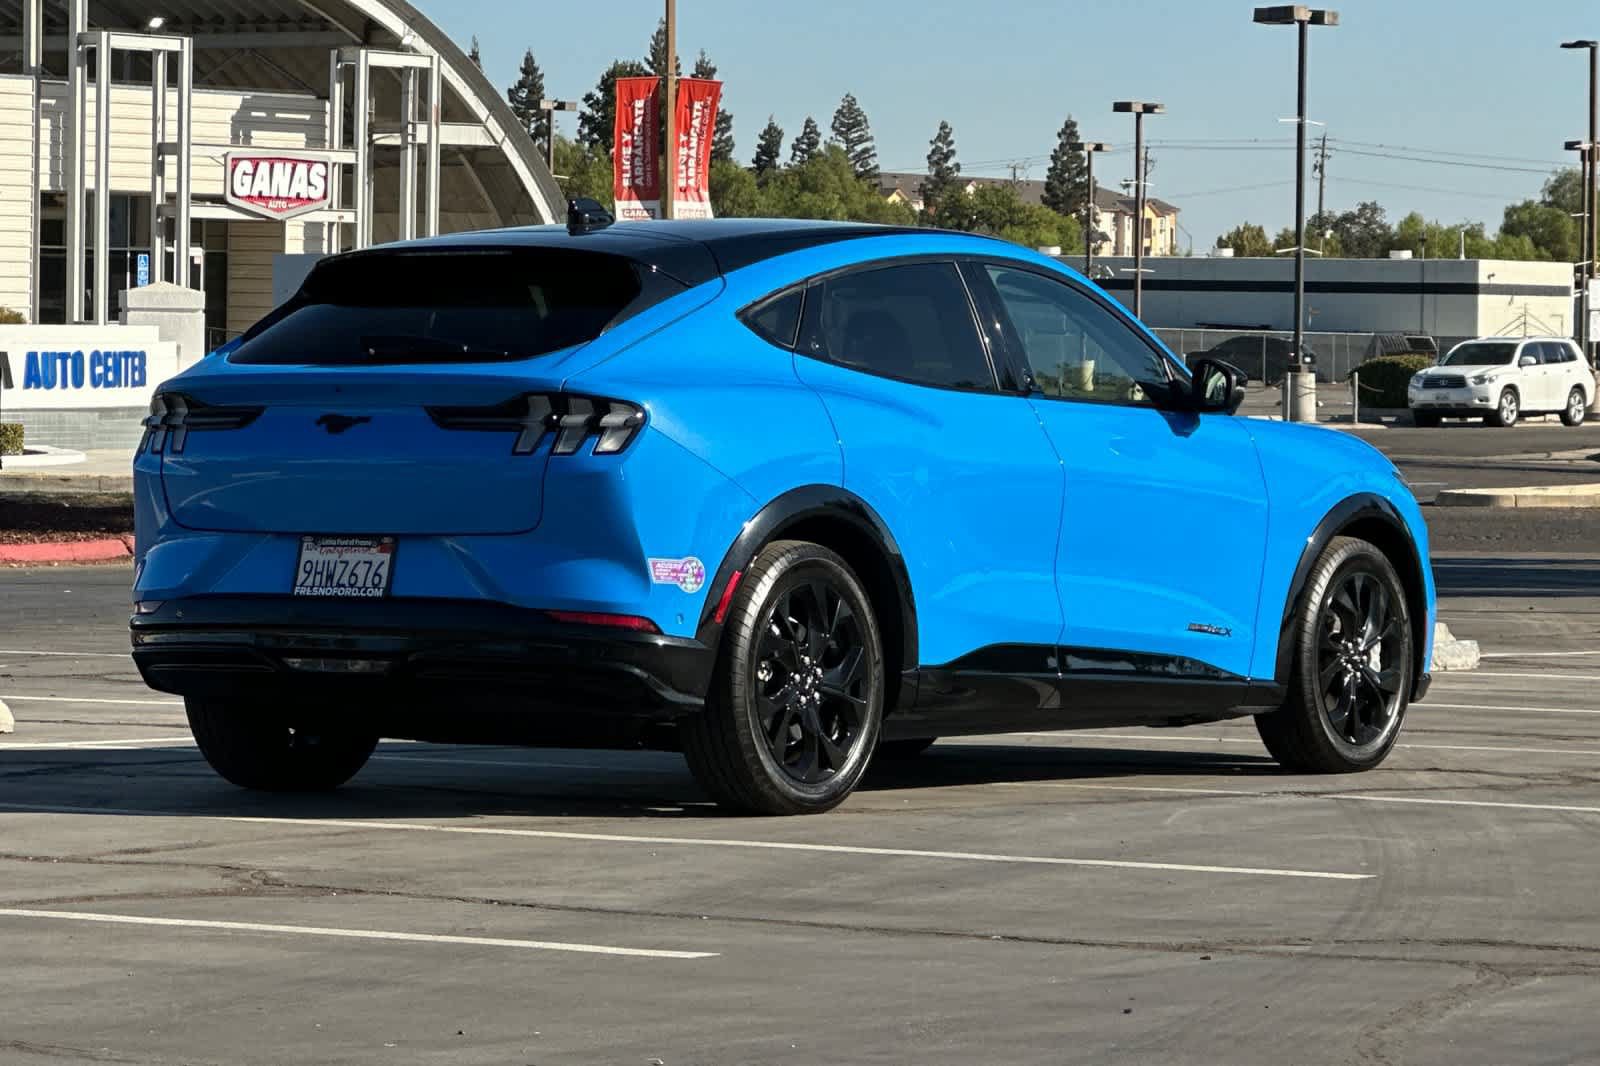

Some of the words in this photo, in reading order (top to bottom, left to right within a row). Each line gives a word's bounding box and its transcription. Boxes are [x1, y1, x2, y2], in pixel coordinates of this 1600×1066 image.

[233, 159, 327, 200] GANAS
[267, 201, 288, 209] AUTO
[23, 350, 85, 390] AUTO
[89, 349, 147, 389] CENTER
[301, 559, 385, 587] 9HWZ676
[294, 586, 384, 597] FRESNOFORD.COM
